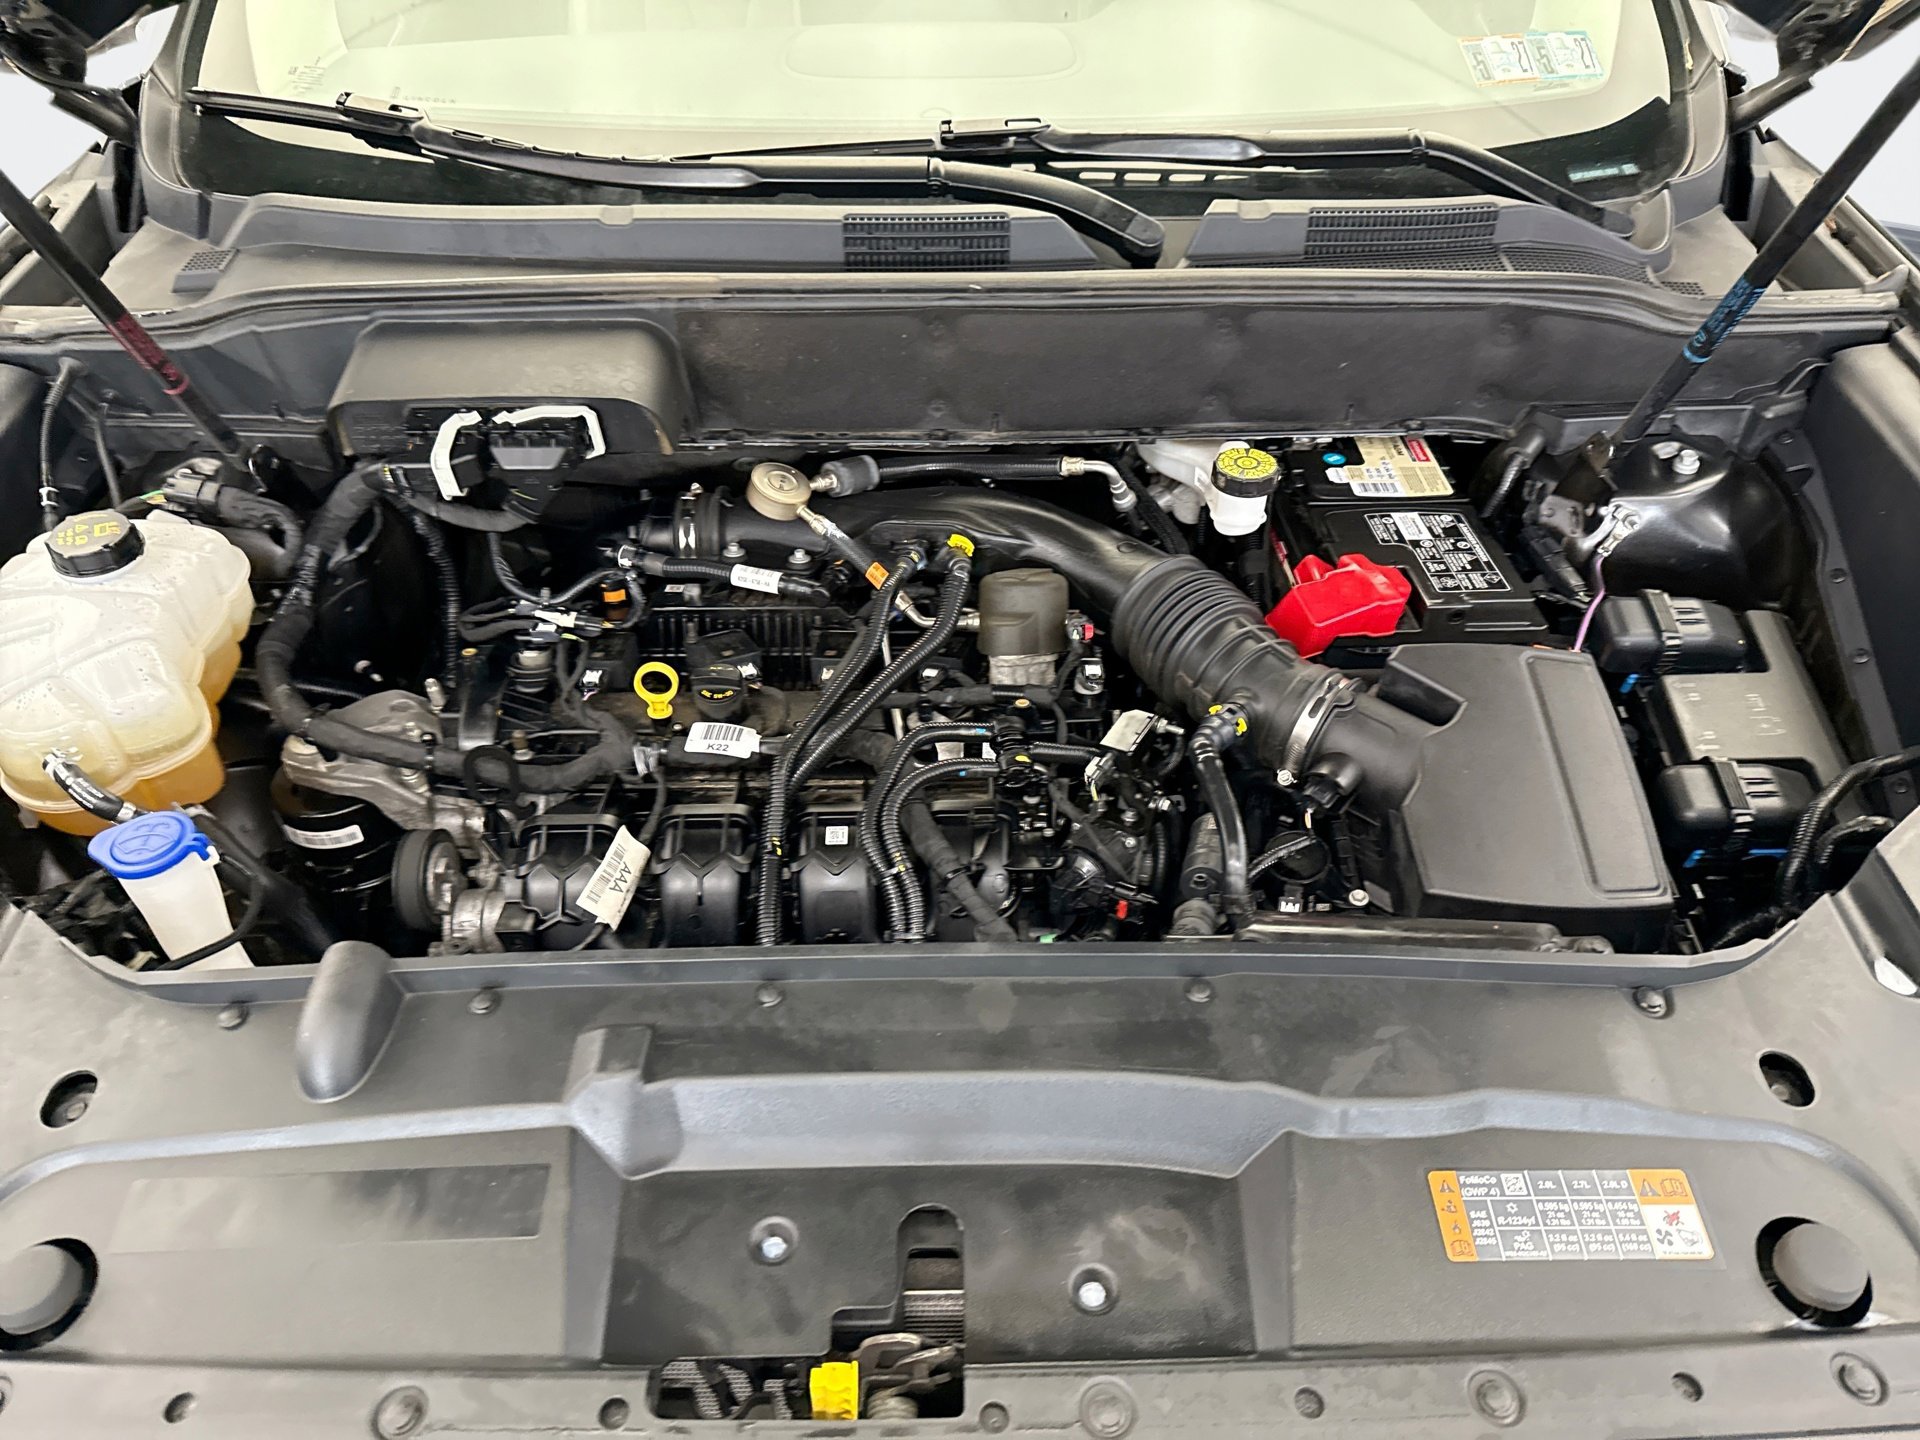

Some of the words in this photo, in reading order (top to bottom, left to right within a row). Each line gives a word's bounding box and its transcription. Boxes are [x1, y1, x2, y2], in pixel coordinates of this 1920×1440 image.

[706, 743, 729, 752] K22
[608, 861, 632, 893] AAA
[1459, 1175, 1497, 1184] FoMoCo
[1571, 1180, 1591, 1189] 2.7L
[1497, 1216, 1536, 1226] R-1234yf
[1513, 1241, 1535, 1251] PAG
